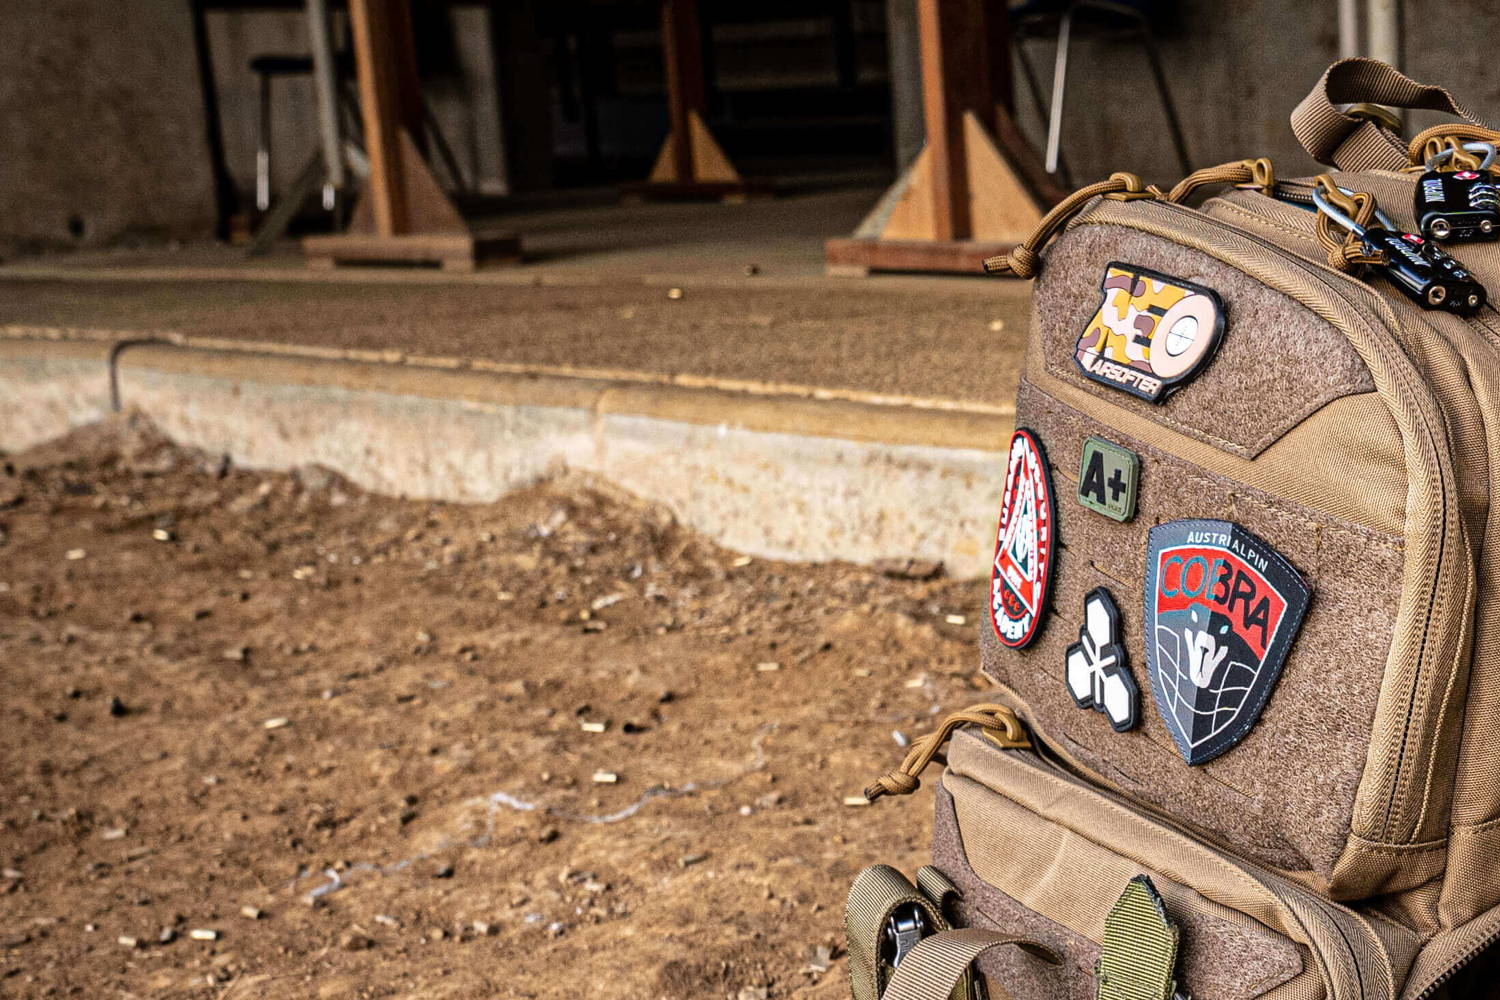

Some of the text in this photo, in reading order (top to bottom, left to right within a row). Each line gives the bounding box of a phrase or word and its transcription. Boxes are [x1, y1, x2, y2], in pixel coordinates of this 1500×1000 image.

[1089, 359, 1163, 395] AIRSOFTER
[1080, 450, 1127, 506] A+
[1186, 531, 1269, 573] AUSTRIALPIN
[1160, 555, 1271, 650] COBRA
